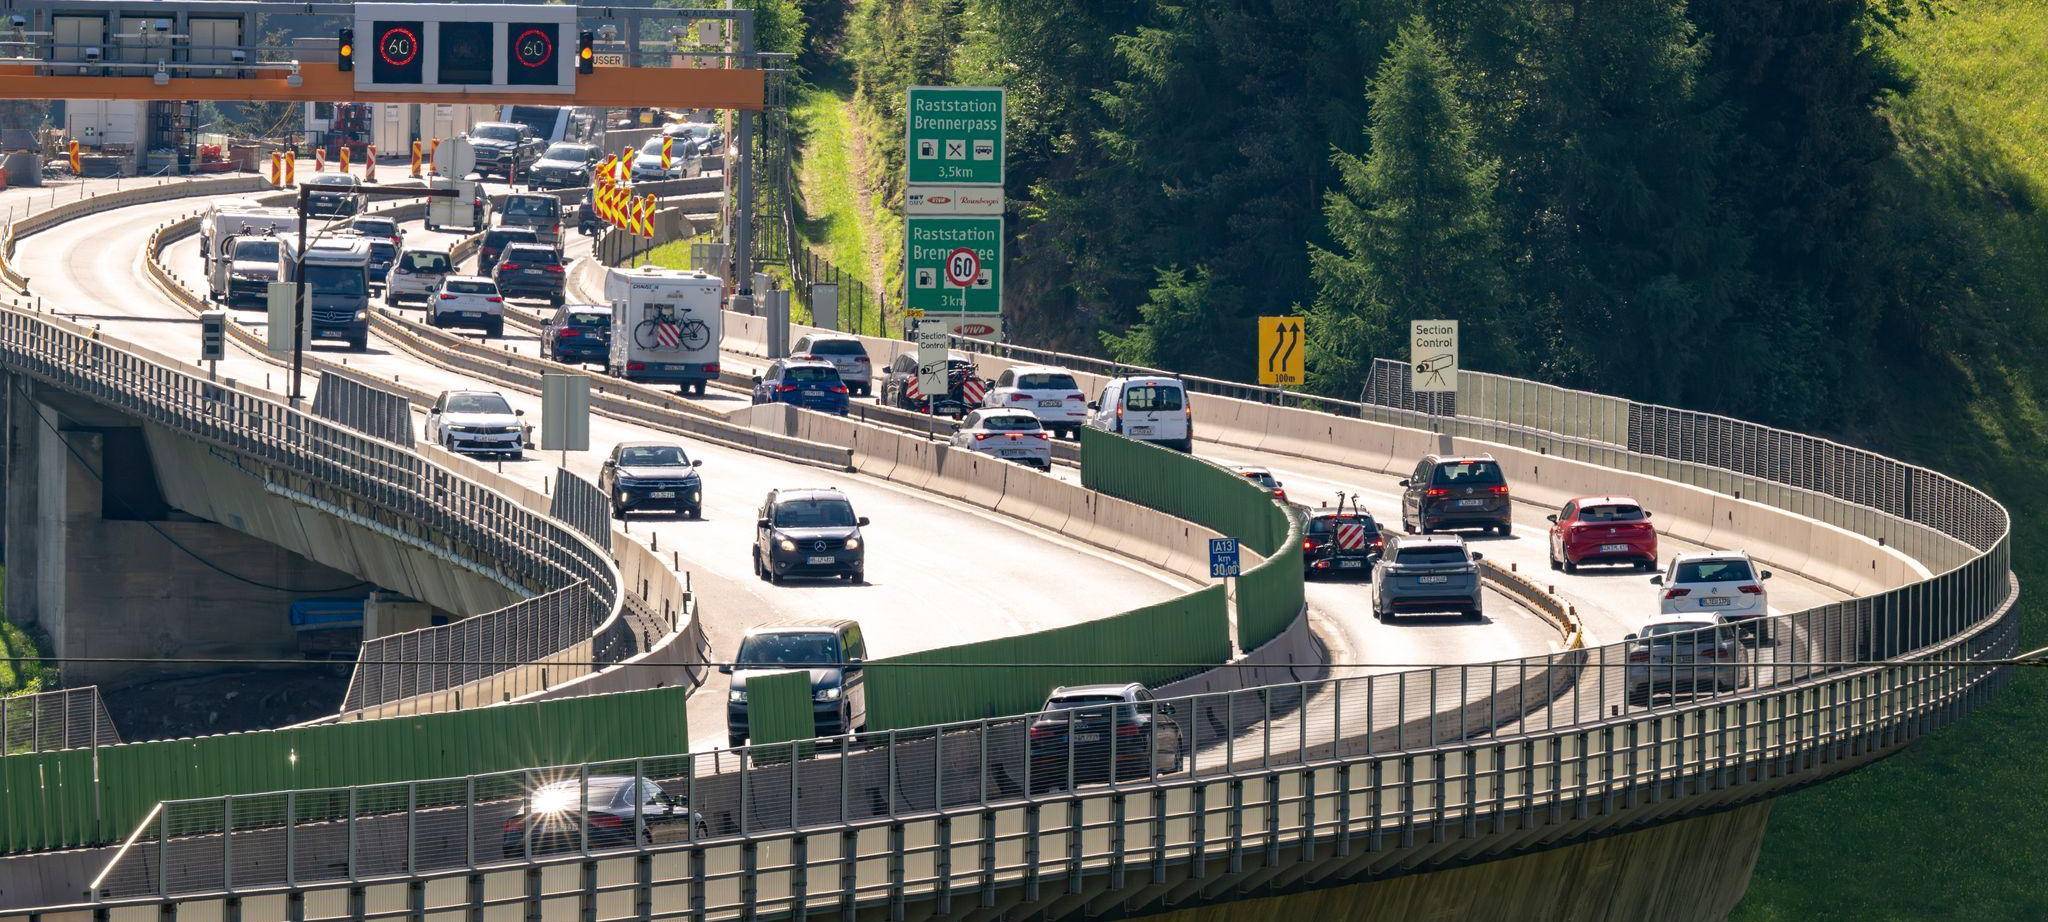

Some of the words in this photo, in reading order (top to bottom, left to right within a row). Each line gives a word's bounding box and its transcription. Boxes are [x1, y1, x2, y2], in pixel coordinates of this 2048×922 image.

[388, 38, 409, 55] 60
[524, 40, 544, 56] 60
[592, 55, 621, 65] USSER
[916, 99, 996, 112] Raststation
[915, 116, 997, 132] Brennerpass
[938, 166, 973, 178] 3,5km
[914, 227, 995, 241] Raststation
[953, 256, 973, 278] 60
[940, 295, 948, 307] 3
[1416, 325, 1453, 335] Section
[920, 332, 947, 340] Section
[920, 342, 946, 350] Control
[1416, 338, 1453, 348] Control
[1275, 373, 1296, 383] 100m
[1215, 541, 1233, 552] A13
[1217, 554, 1231, 563] km
